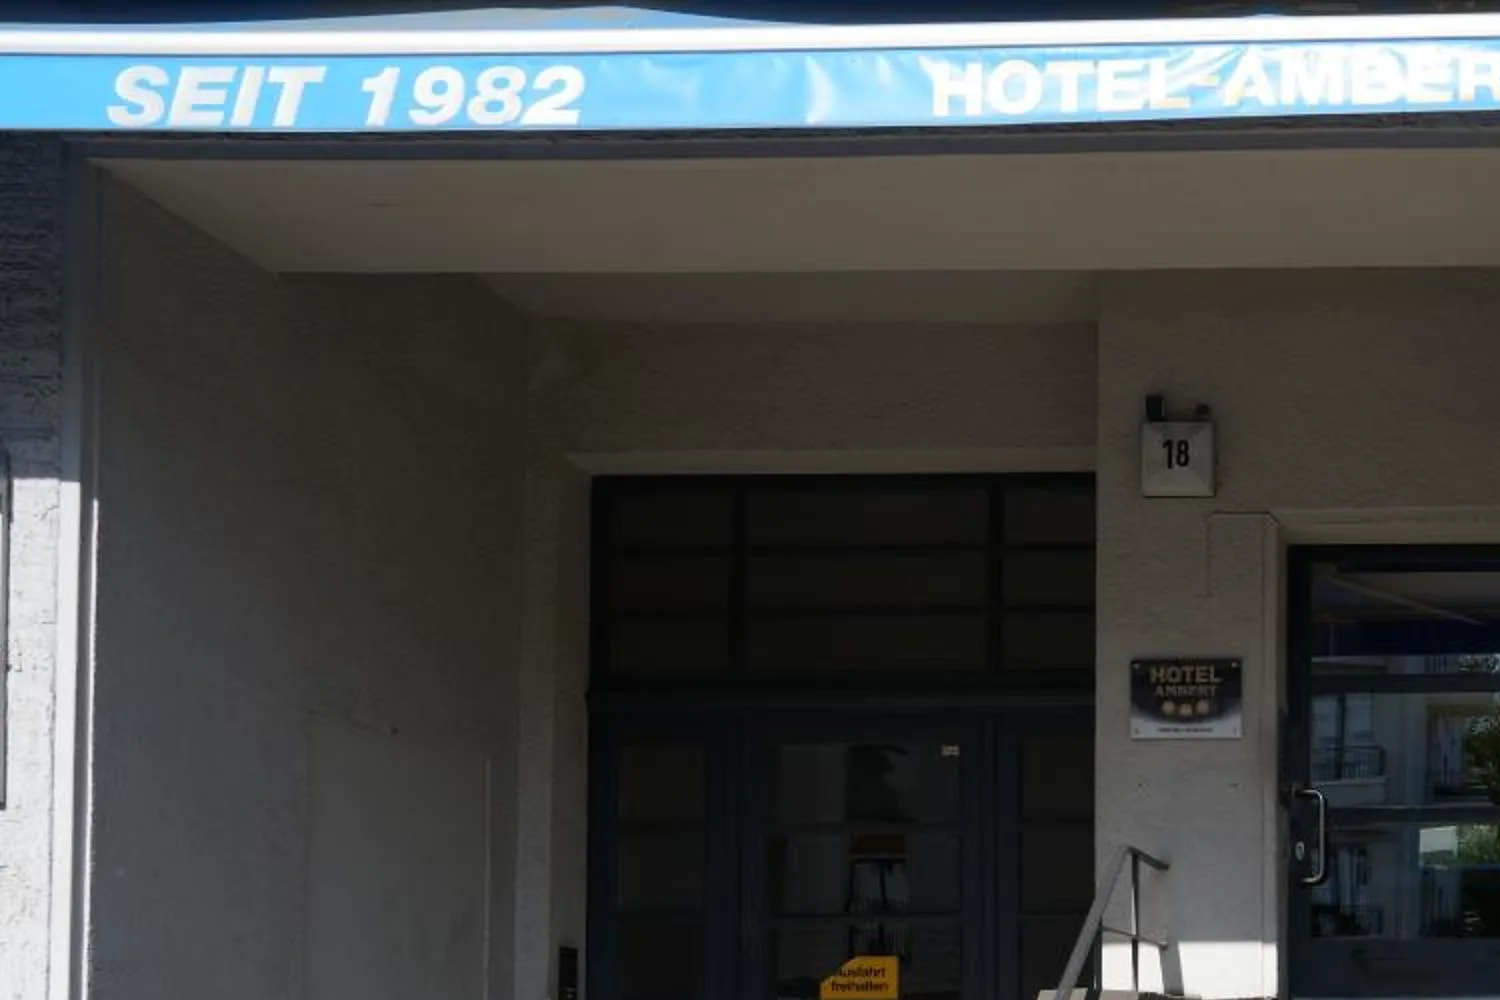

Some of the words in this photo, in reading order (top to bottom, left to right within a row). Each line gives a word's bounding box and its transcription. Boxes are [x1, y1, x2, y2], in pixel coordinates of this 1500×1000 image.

[106, 65, 327, 128] SEIT
[360, 65, 586, 127] 1982
[1162, 438, 1191, 470] 18
[1151, 666, 1223, 683] HOTEL
